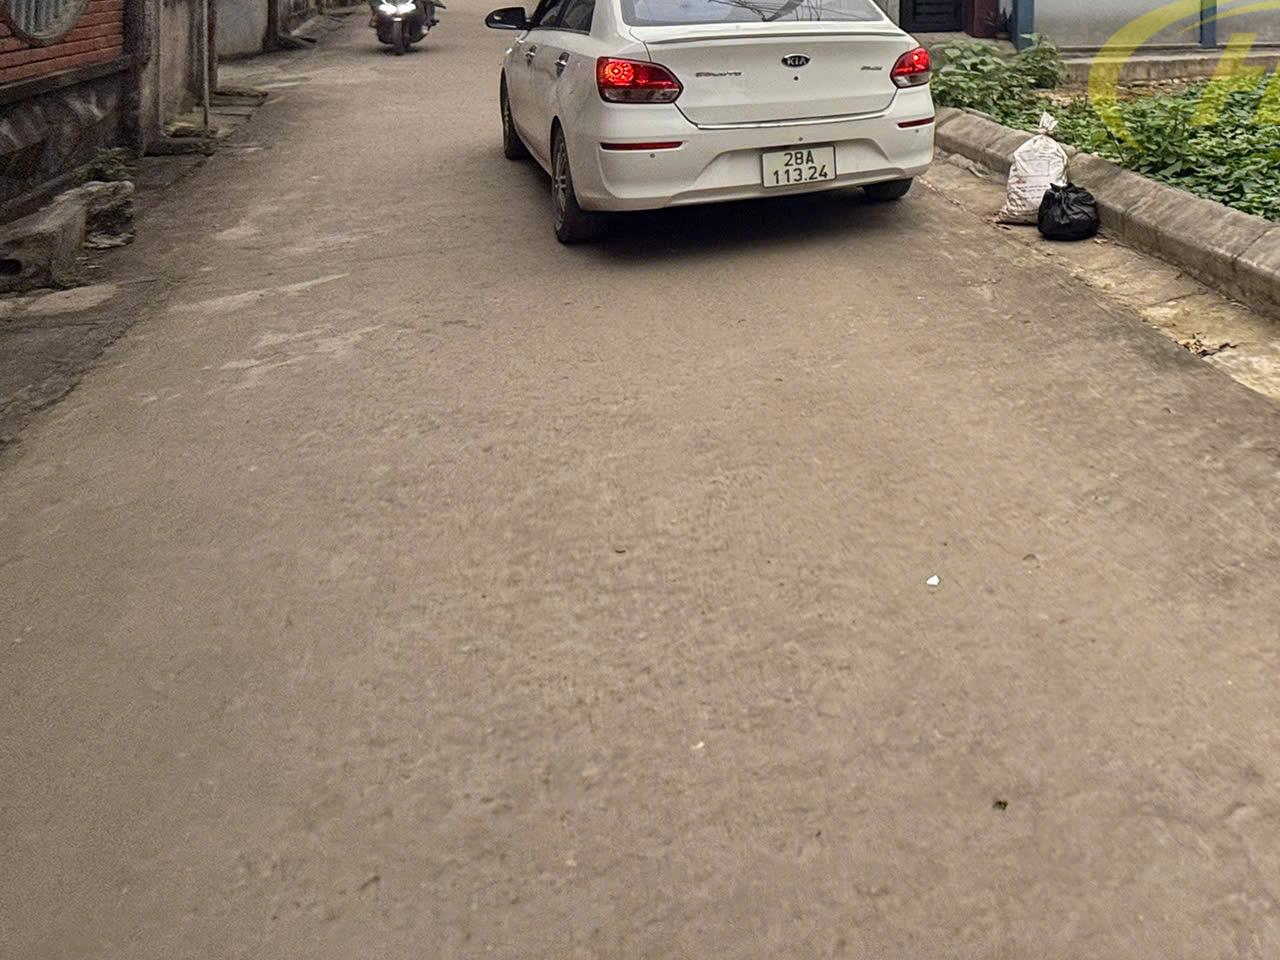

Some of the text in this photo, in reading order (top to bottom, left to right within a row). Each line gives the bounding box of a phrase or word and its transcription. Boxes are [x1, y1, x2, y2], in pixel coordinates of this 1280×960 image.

[786, 56, 808, 66] KIA
[783, 149, 815, 168] 28A
[773, 164, 828, 185] 113.24
